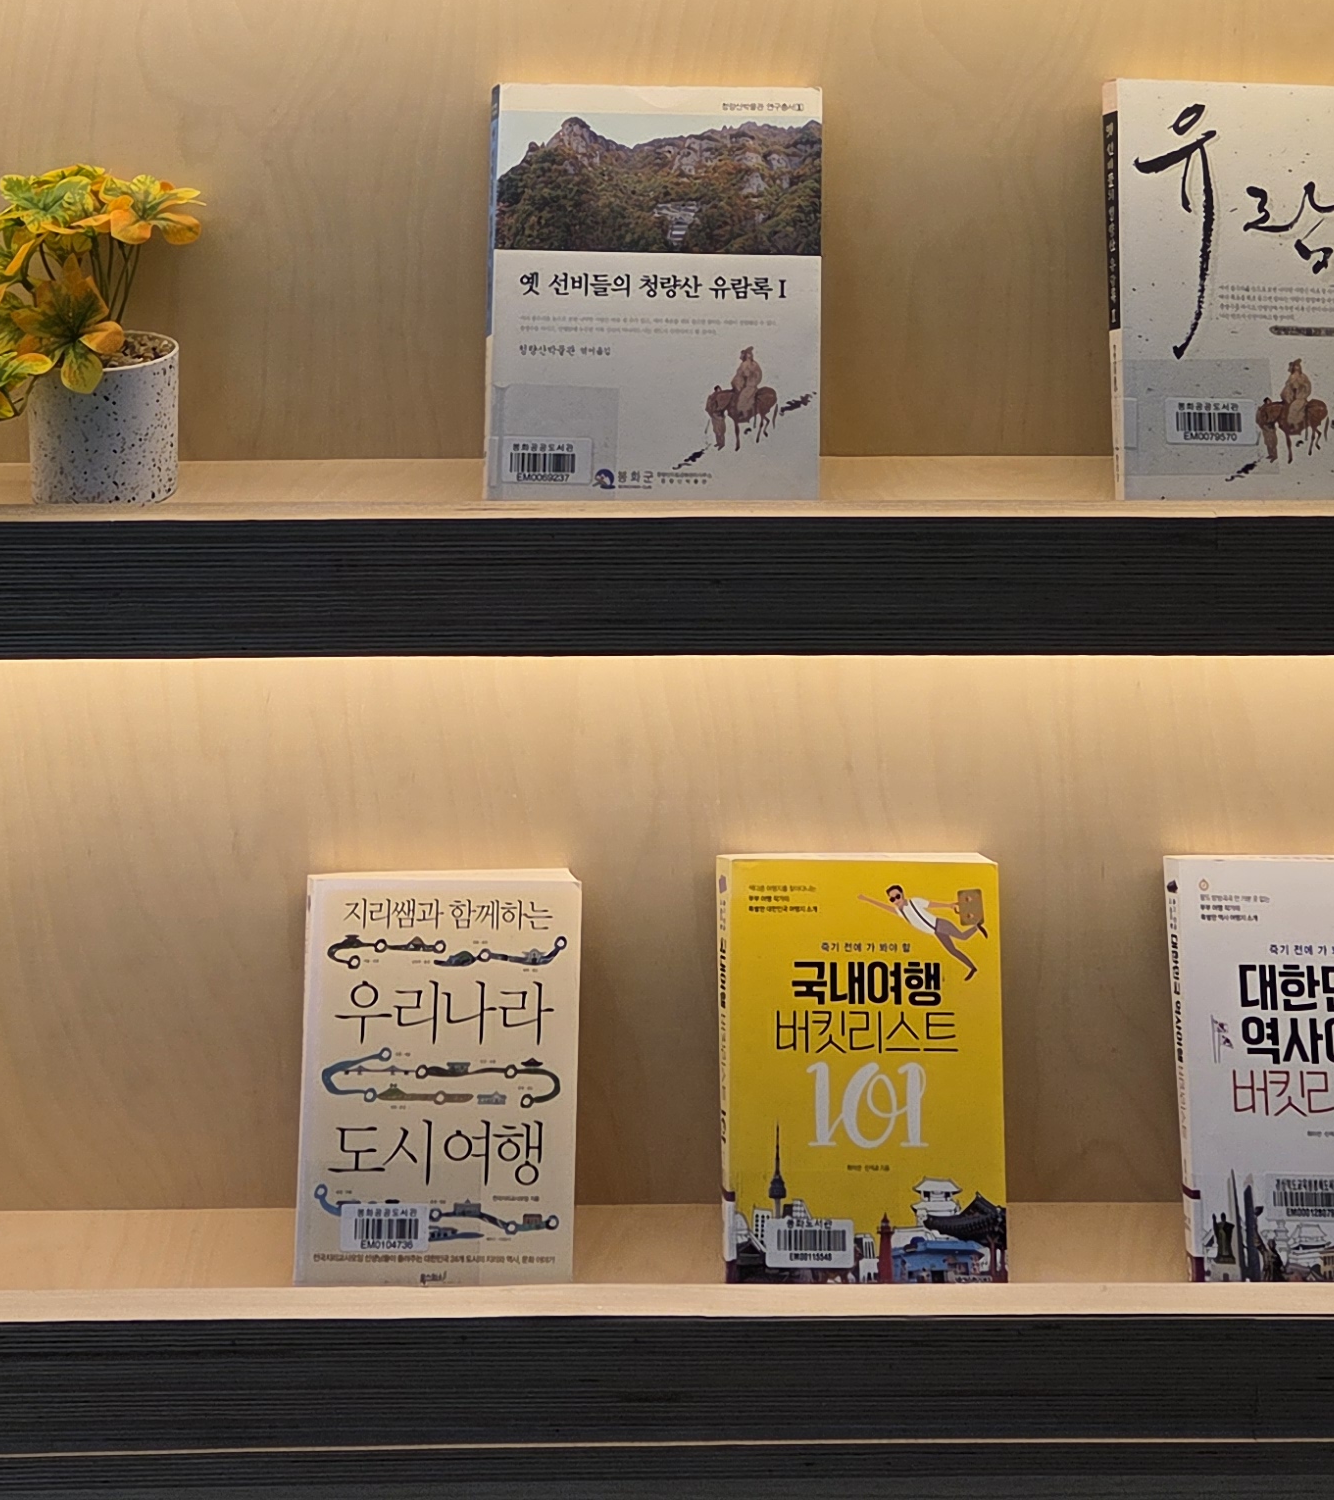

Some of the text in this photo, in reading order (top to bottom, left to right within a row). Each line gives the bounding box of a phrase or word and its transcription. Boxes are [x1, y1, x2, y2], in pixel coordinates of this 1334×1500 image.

[519, 271, 540, 297] 옛
[549, 272, 631, 298] 선비들의
[639, 274, 703, 298] 청량산
[708, 275, 773, 300] 유람록
[344, 898, 554, 931] 지리쌤과 함께하는
[821, 942, 840, 952] 죽기
[844, 942, 862, 953] 전에
[867, 943, 875, 953] 가
[1269, 944, 1290, 955] 죽기
[1294, 944, 1313, 956] 전에
[1317, 945, 1327, 956] 가
[791, 960, 942, 1007] 국내여행
[334, 980, 554, 1046] 우리나라
[775, 1011, 959, 1054] 버킷리스트
[805, 1061, 929, 1149] 101
